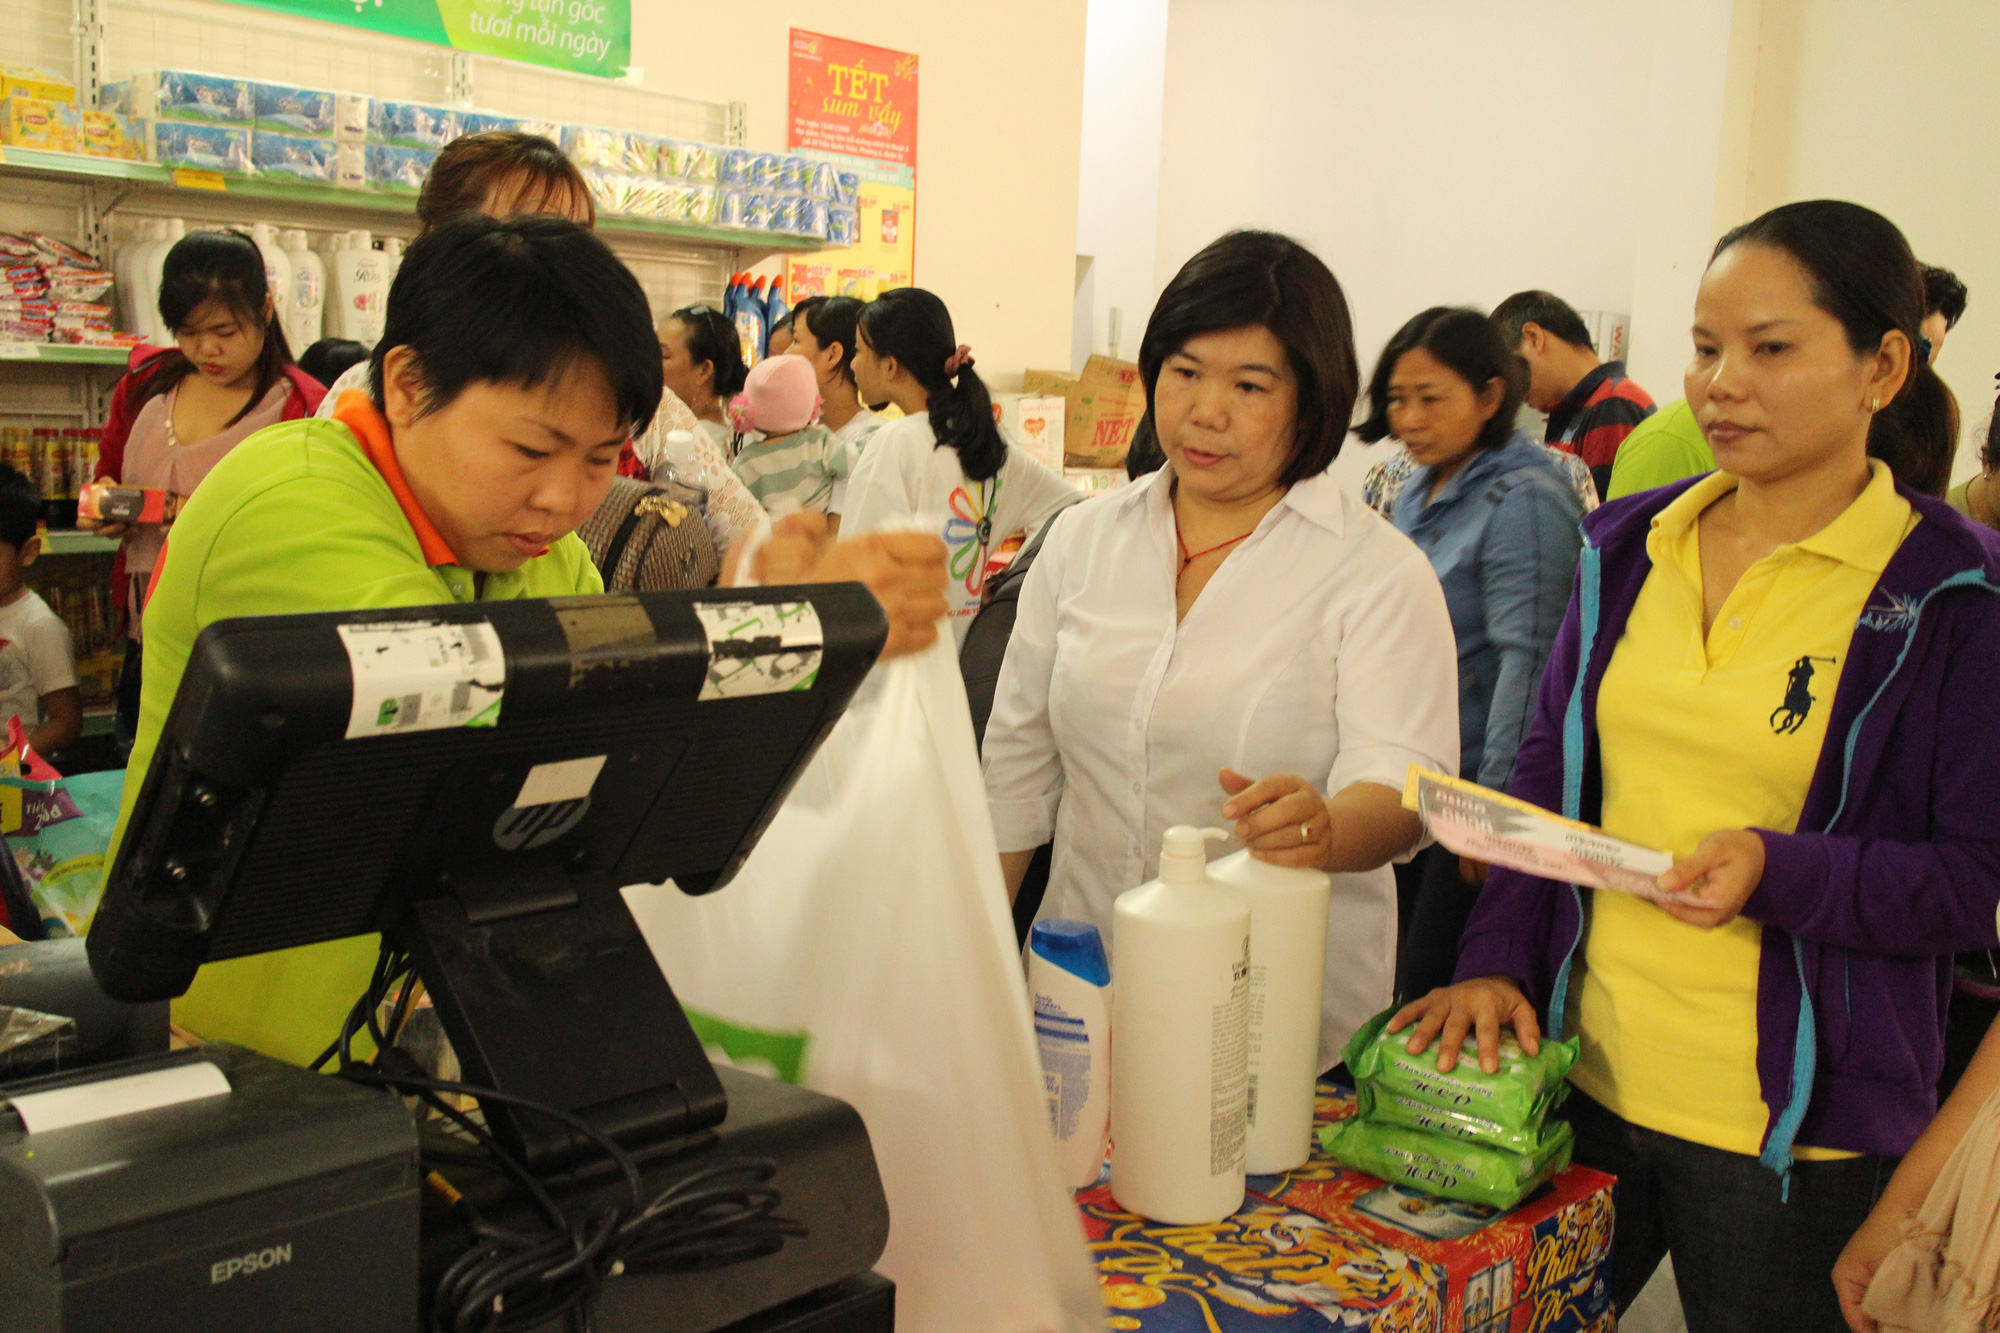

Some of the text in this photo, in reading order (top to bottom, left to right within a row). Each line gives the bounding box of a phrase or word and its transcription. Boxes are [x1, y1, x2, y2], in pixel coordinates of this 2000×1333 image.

[469, 10, 514, 39] tươi
[560, 30, 611, 62] ngày
[827, 58, 889, 104] TẾT
[823, 97, 862, 118] sum
[1091, 418, 1134, 446] NET
[211, 1242, 293, 1285] EPSON
